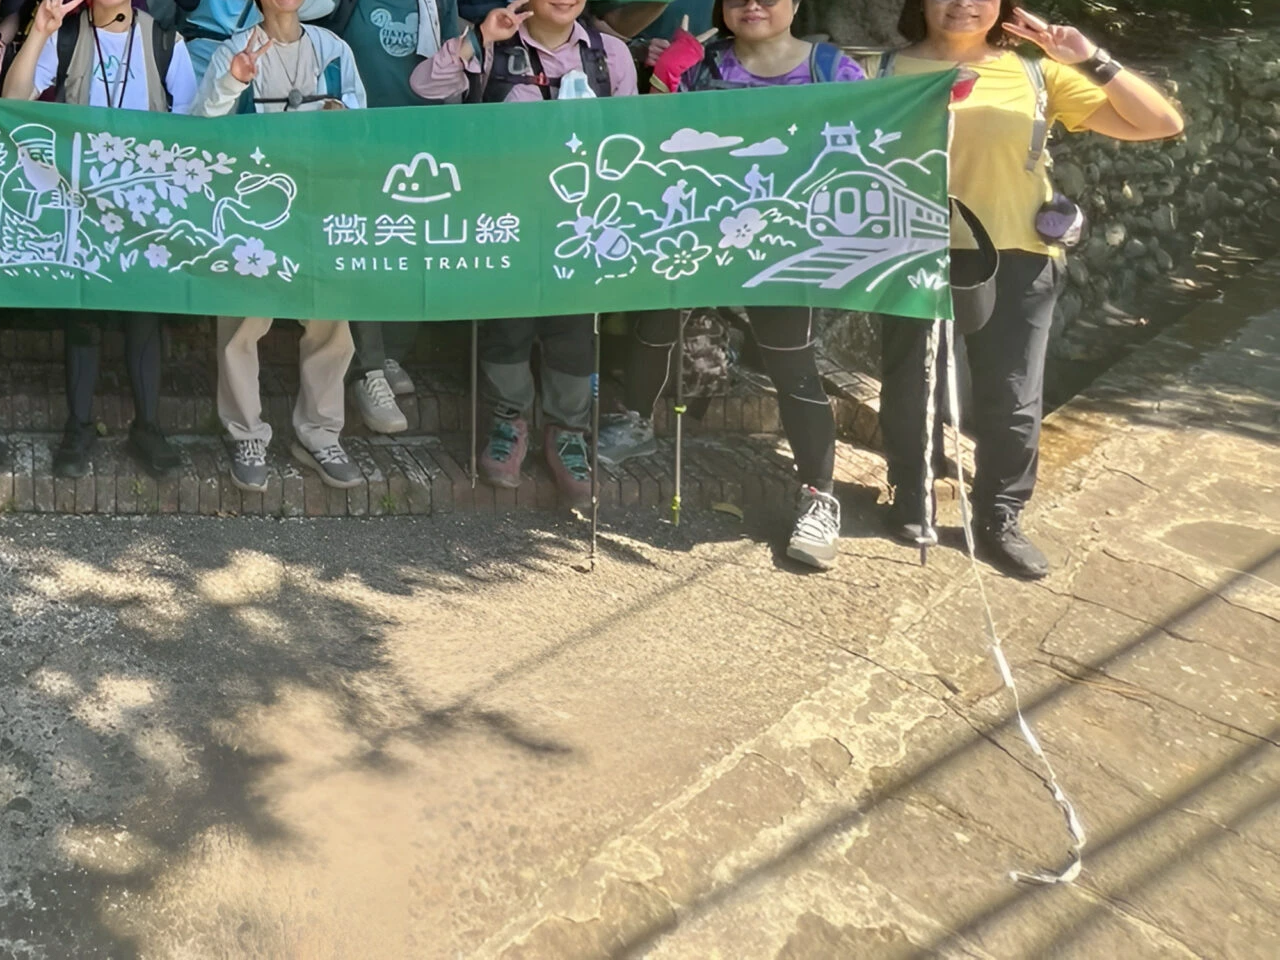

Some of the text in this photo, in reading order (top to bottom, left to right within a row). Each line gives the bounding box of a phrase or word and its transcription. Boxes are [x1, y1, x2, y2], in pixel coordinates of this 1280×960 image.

[322, 213, 521, 246] 微笑山線
[335, 255, 511, 271] SMILE TRAILS
